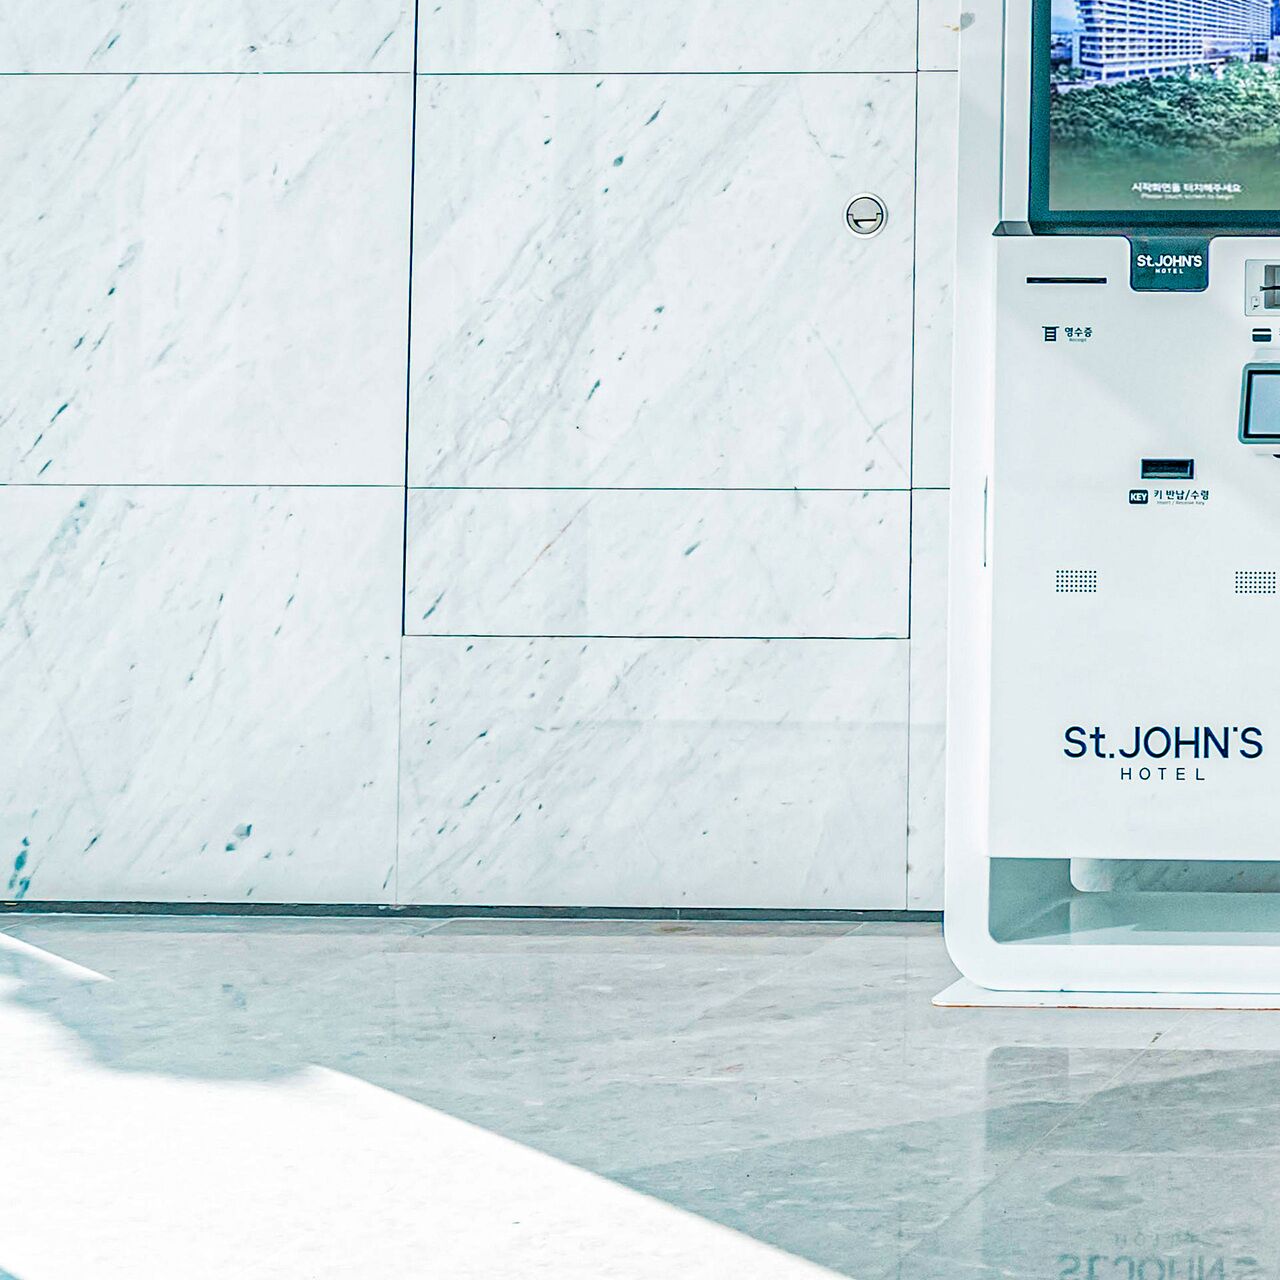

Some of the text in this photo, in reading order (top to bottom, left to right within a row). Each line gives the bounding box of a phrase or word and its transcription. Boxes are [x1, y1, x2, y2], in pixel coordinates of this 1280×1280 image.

[1137, 254, 1202, 268] St.JOHN'S
[1064, 327, 1093, 338] 영수증
[1130, 492, 1147, 501] KEY
[1153, 489, 1209, 501] 키 반납/수령
[1063, 726, 1263, 759] St.JOHN'S
[1120, 767, 1205, 780] HOTEL
